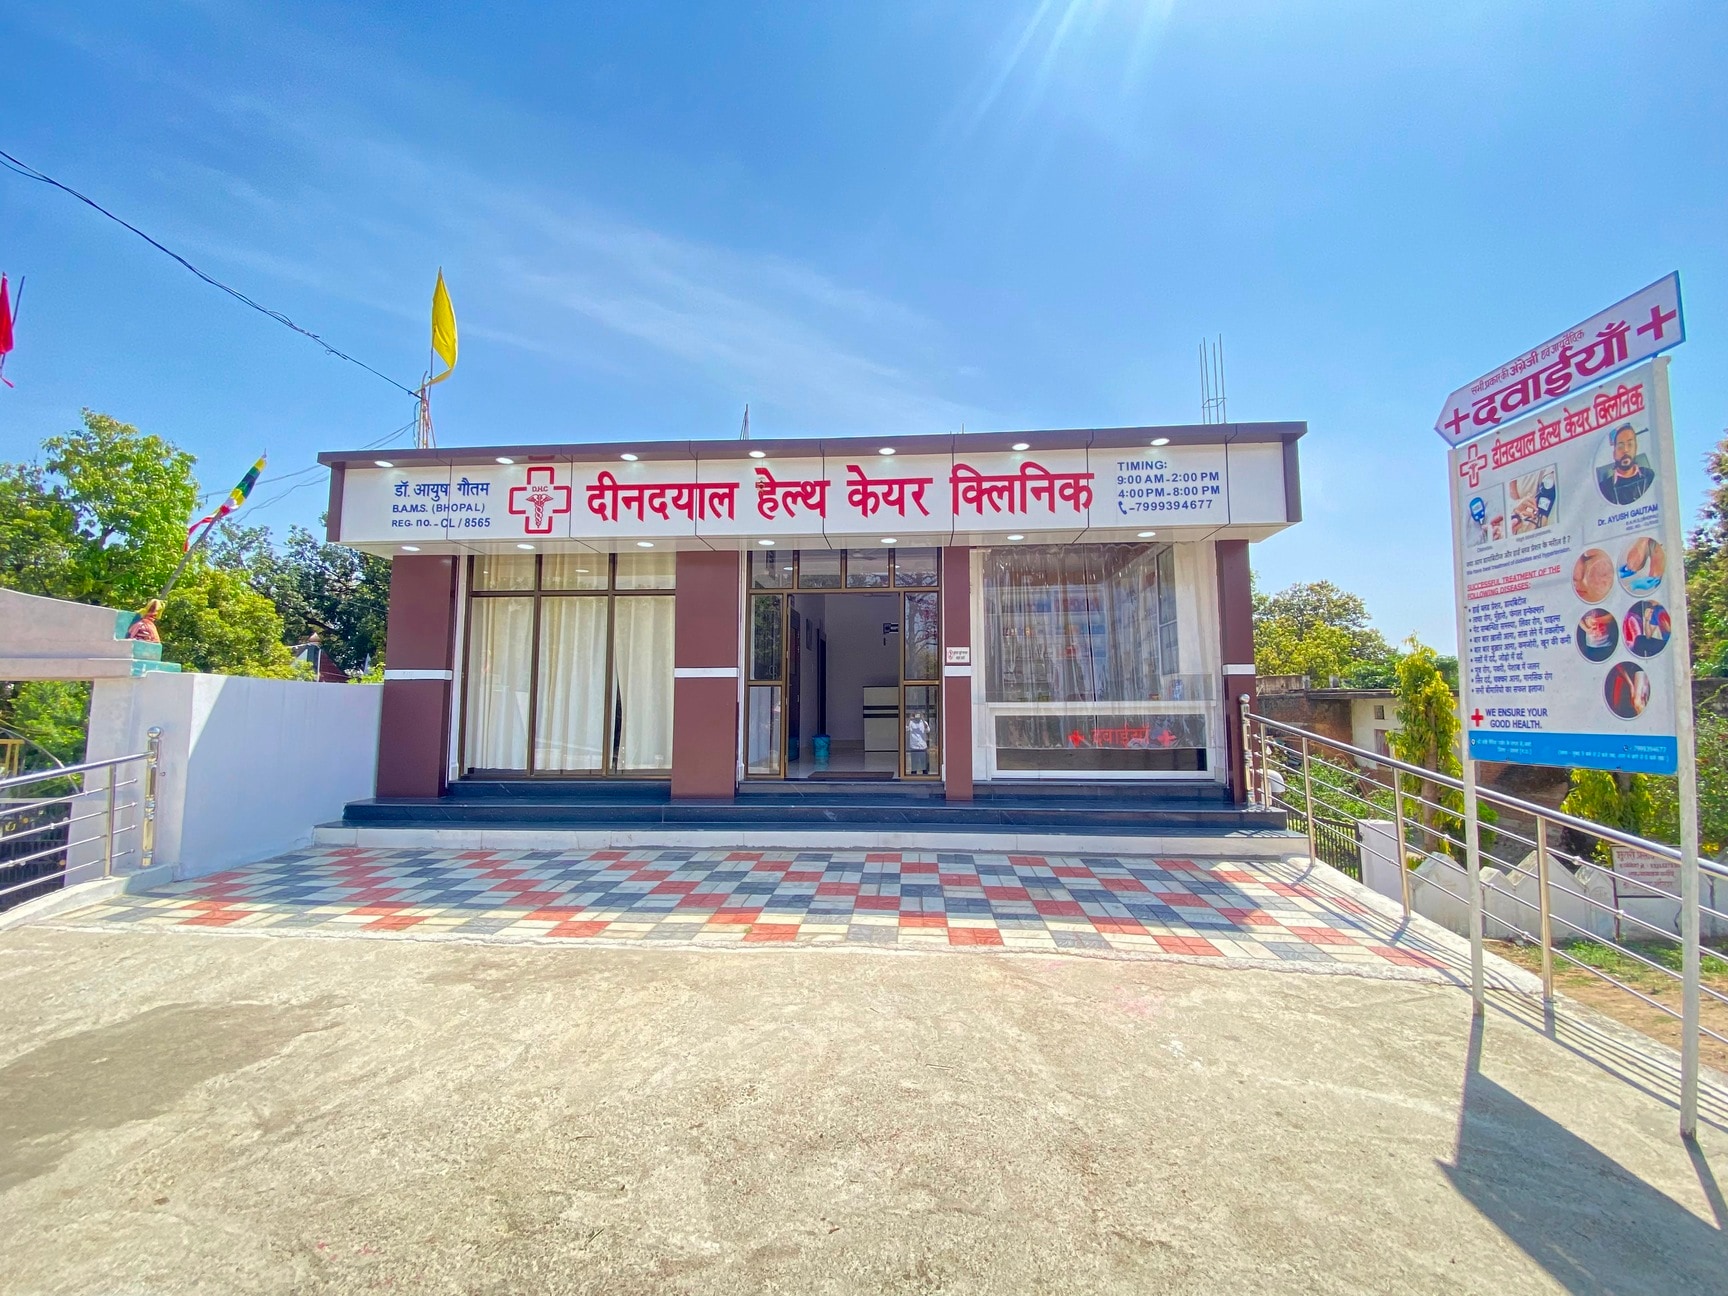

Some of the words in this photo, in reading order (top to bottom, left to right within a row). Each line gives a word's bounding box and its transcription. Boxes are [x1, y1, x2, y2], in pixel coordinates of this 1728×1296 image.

[1472, 320, 1631, 426] दवाईयाँ
[1491, 431, 1536, 466] दीनदयाल
[1537, 418, 1562, 447] हेल्थ
[1564, 407, 1591, 436] केयर
[1593, 383, 1645, 425] क्लिनिक
[1117, 460, 1167, 471] TIMING:
[1117, 475, 1142, 485] 9:00
[1144, 474, 1164, 484] AM
[1171, 473, 1198, 482] 2:00
[1200, 471, 1219, 481] PM
[394, 480, 410, 497] डॉ.
[413, 483, 450, 501] आयुष
[457, 477, 491, 496] गौतम
[586, 470, 740, 522] दीनदयाल
[755, 467, 831, 520] हेल्थ
[846, 464, 933, 518] केयर
[949, 461, 1095, 516] क्लिनिक
[1118, 488, 1144, 498] 4:00
[1146, 487, 1165, 497] PM
[1173, 487, 1198, 496] 8:00
[1202, 485, 1220, 495] PM
[392, 504, 428, 513] B.A.M.S.
[431, 503, 485, 513] (BHOPAL)
[1597, 519, 1607, 527] Dr.
[1607, 511, 1629, 524] AYUSH
[1630, 503, 1658, 517] GAUTAM
[464, 517, 491, 528] 8565
[1502, 570, 1537, 583] TREATMENT
[1538, 568, 1547, 576] OF
[1548, 565, 1560, 574] THE
[1467, 588, 1499, 600] FOLLOWING
[1485, 708, 1496, 716] WE
[1498, 708, 1525, 716] ENSURE
[1527, 708, 1548, 717] YOUR
[1490, 720, 1510, 728] GOOD
[1512, 720, 1542, 729] HEALTH.
